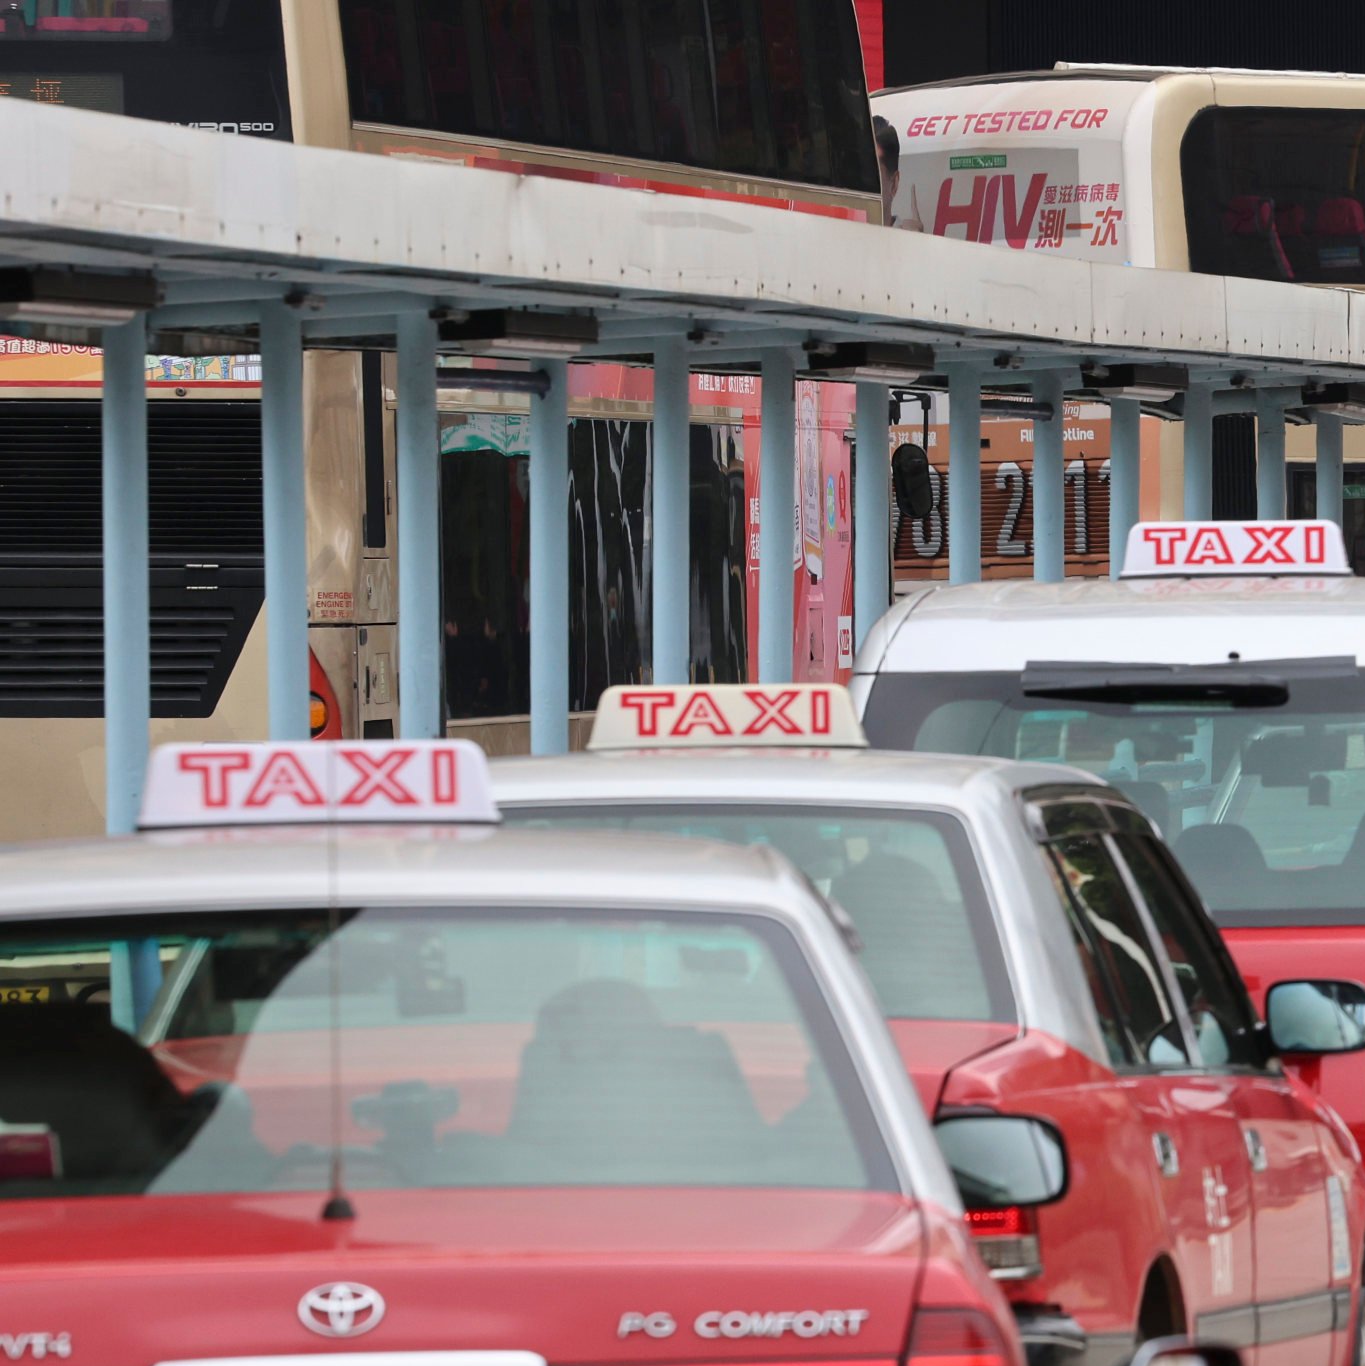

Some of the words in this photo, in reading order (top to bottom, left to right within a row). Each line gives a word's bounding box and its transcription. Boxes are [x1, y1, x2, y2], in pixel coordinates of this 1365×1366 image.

[906, 115, 957, 138] GET
[962, 109, 1052, 135] TESTED
[1053, 108, 1109, 130] FOR
[932, 173, 1048, 250] HIV
[1043, 183, 1120, 205] 愛滋病病毒
[1034, 206, 1123, 248] 測一次
[1143, 520, 1326, 566] TAXI
[620, 690, 832, 737] TAXI
[179, 749, 458, 808] TAXI
[616, 1310, 678, 1340] PG
[694, 1309, 870, 1339] COMFORT
